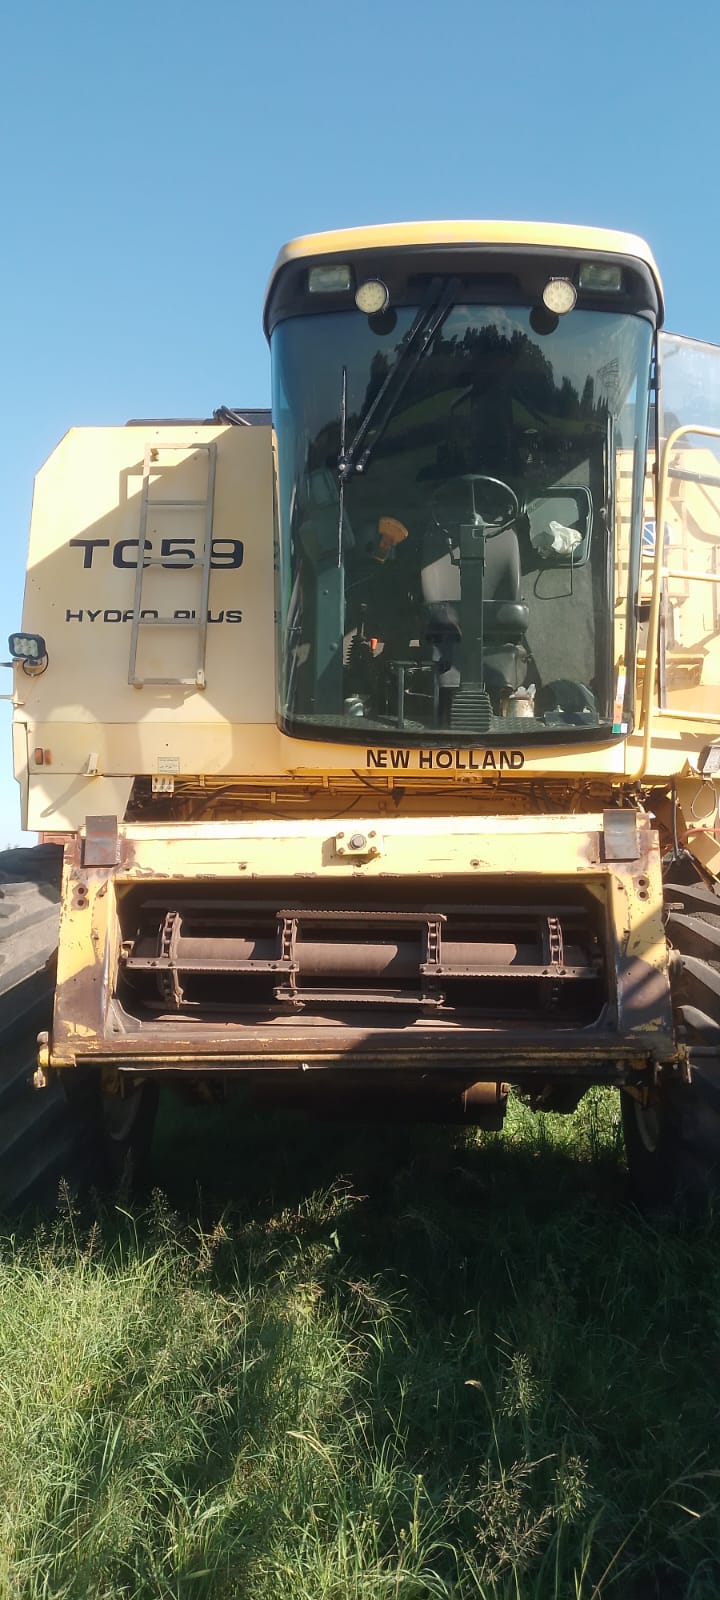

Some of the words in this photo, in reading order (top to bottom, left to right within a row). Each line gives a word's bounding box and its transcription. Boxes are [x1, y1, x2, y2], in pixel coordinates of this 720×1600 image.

[69, 538, 244, 569] TC59
[366, 749, 410, 768] NEW
[419, 750, 525, 770] HOLLAND
